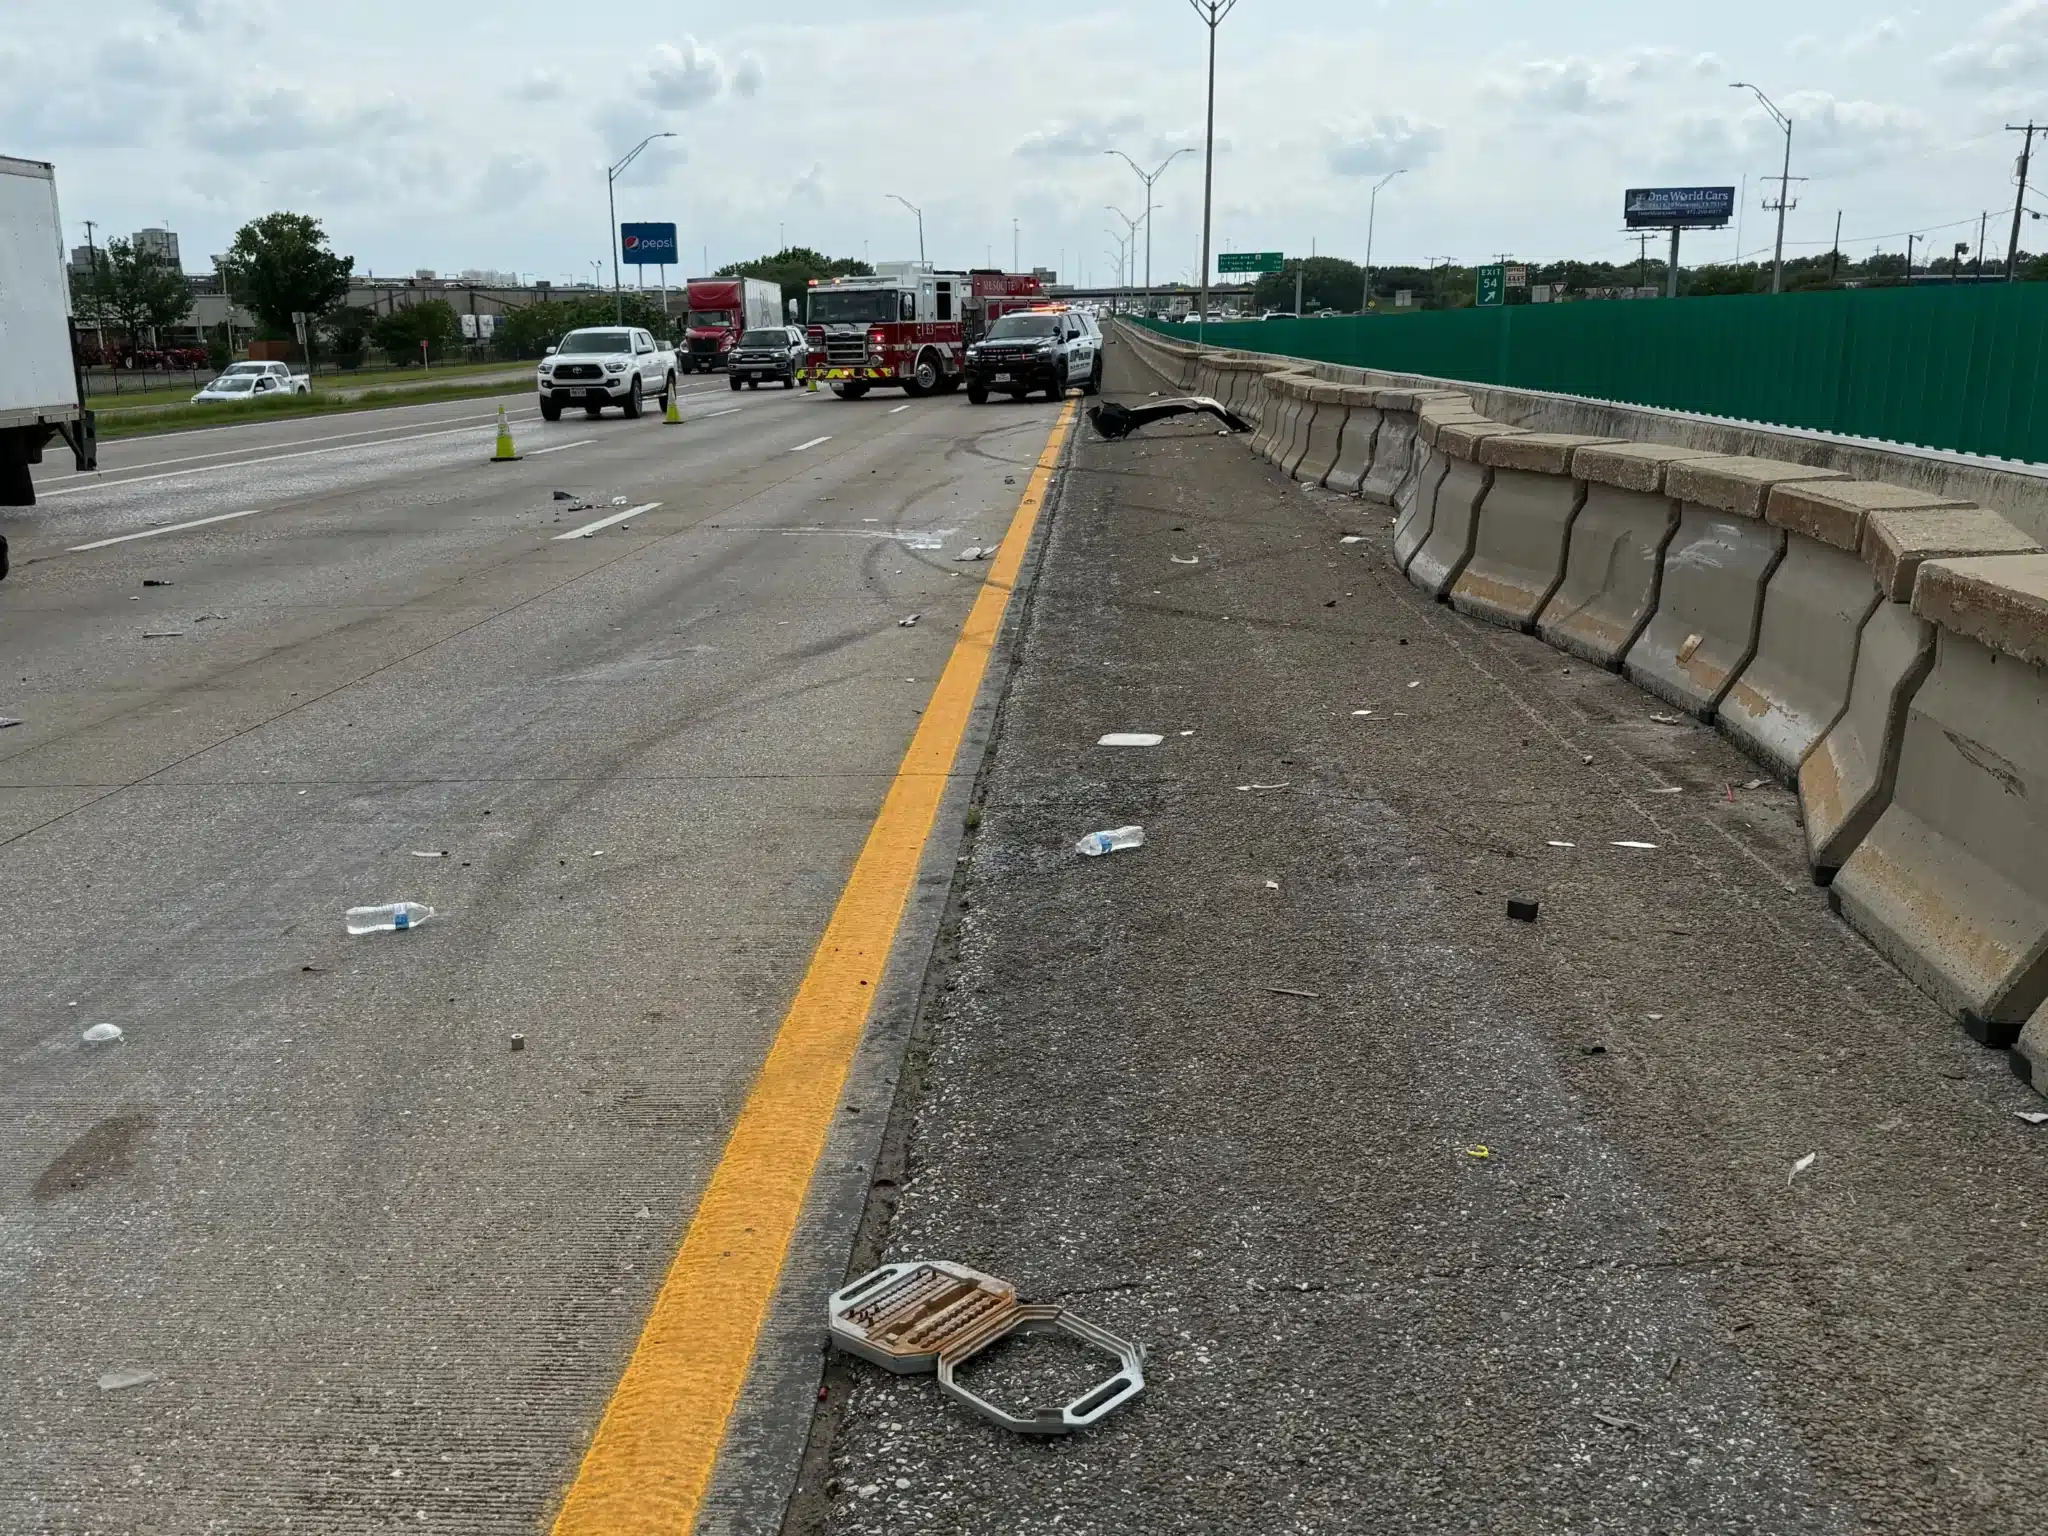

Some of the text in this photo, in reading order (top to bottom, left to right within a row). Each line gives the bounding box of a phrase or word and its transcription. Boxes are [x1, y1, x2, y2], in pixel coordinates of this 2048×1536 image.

[1648, 190, 1729, 201] One World Cars
[641, 238, 674, 250] pepsi
[1481, 268, 1500, 276] EXIT
[1483, 278, 1498, 288] 54
